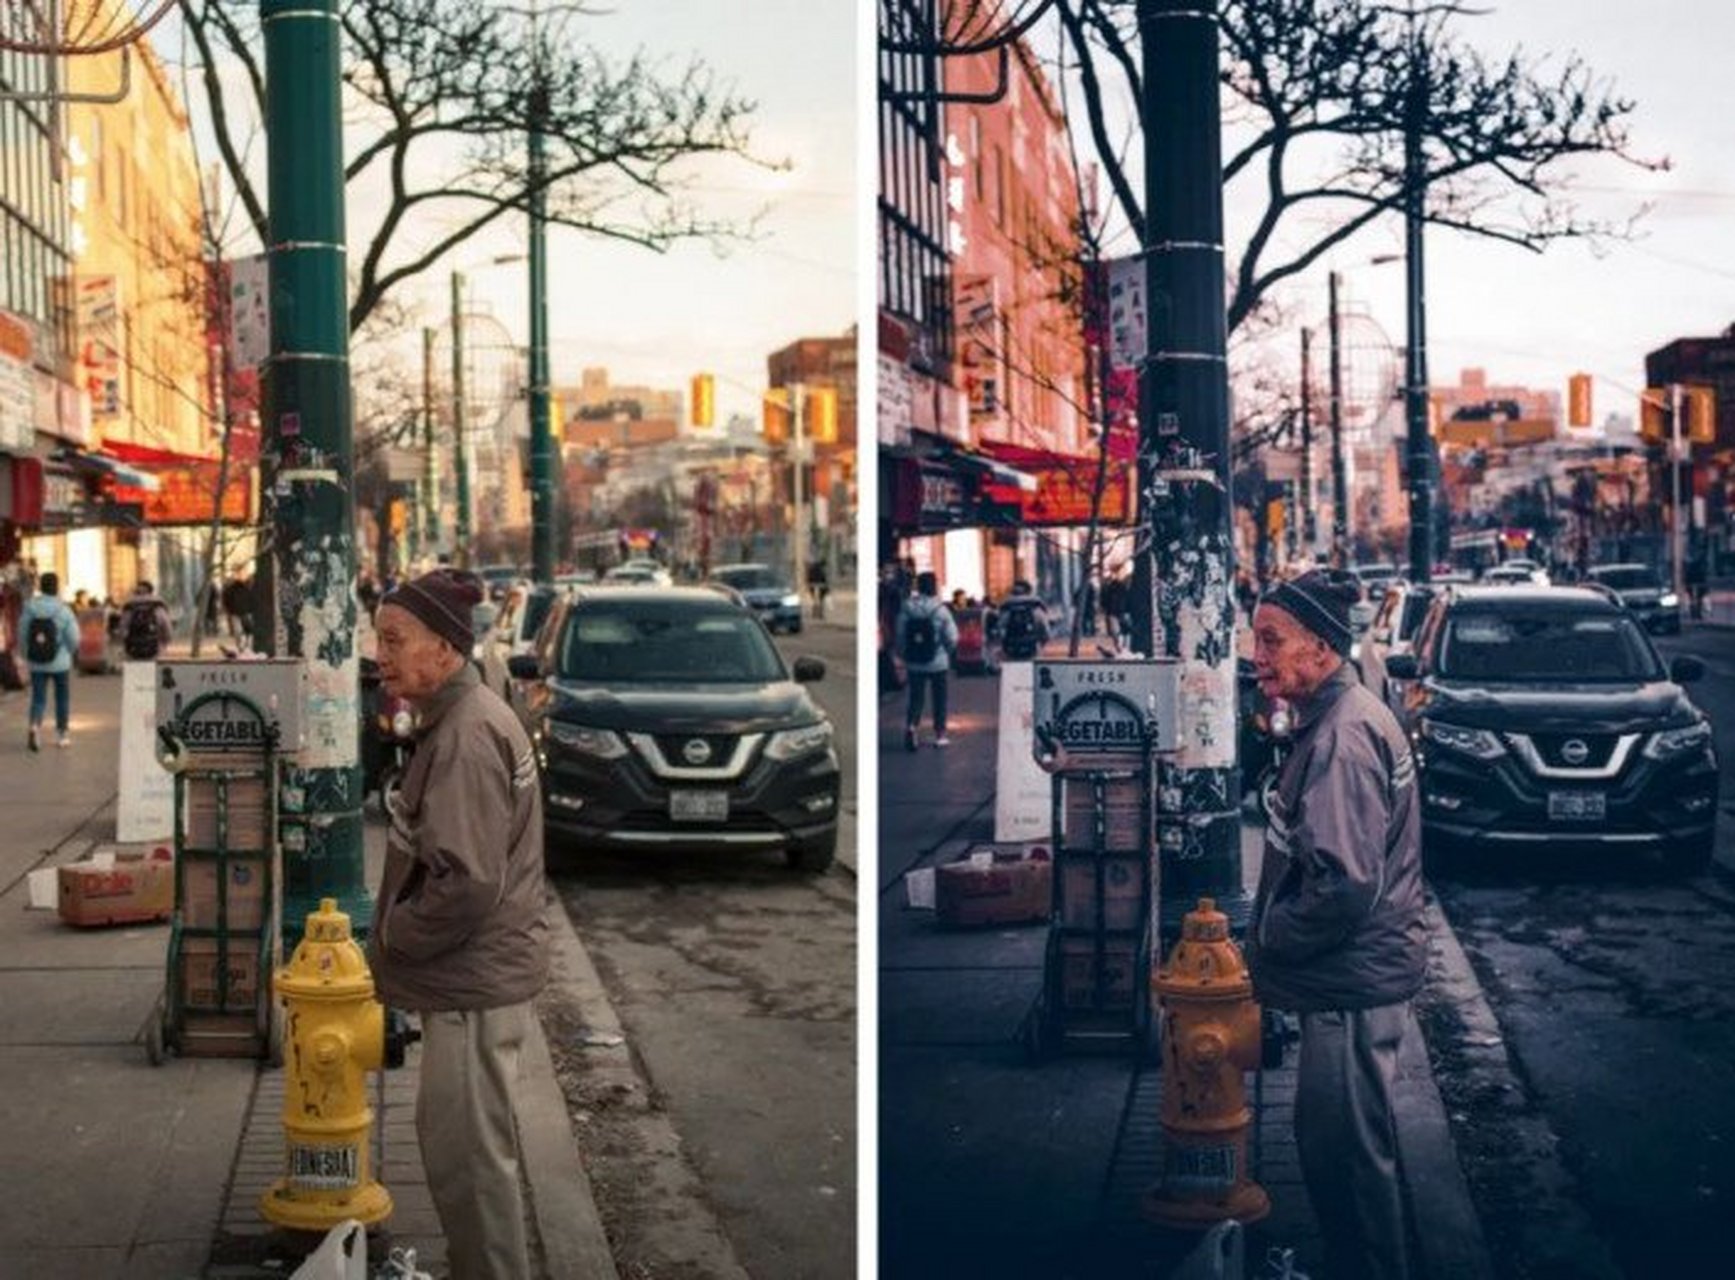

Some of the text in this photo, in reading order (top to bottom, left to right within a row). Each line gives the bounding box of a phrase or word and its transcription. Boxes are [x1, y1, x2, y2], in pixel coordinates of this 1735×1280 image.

[1077, 671, 1126, 683] FRESH
[165, 720, 281, 740] EGETABLS
[1044, 720, 1159, 740] EGETABLS
